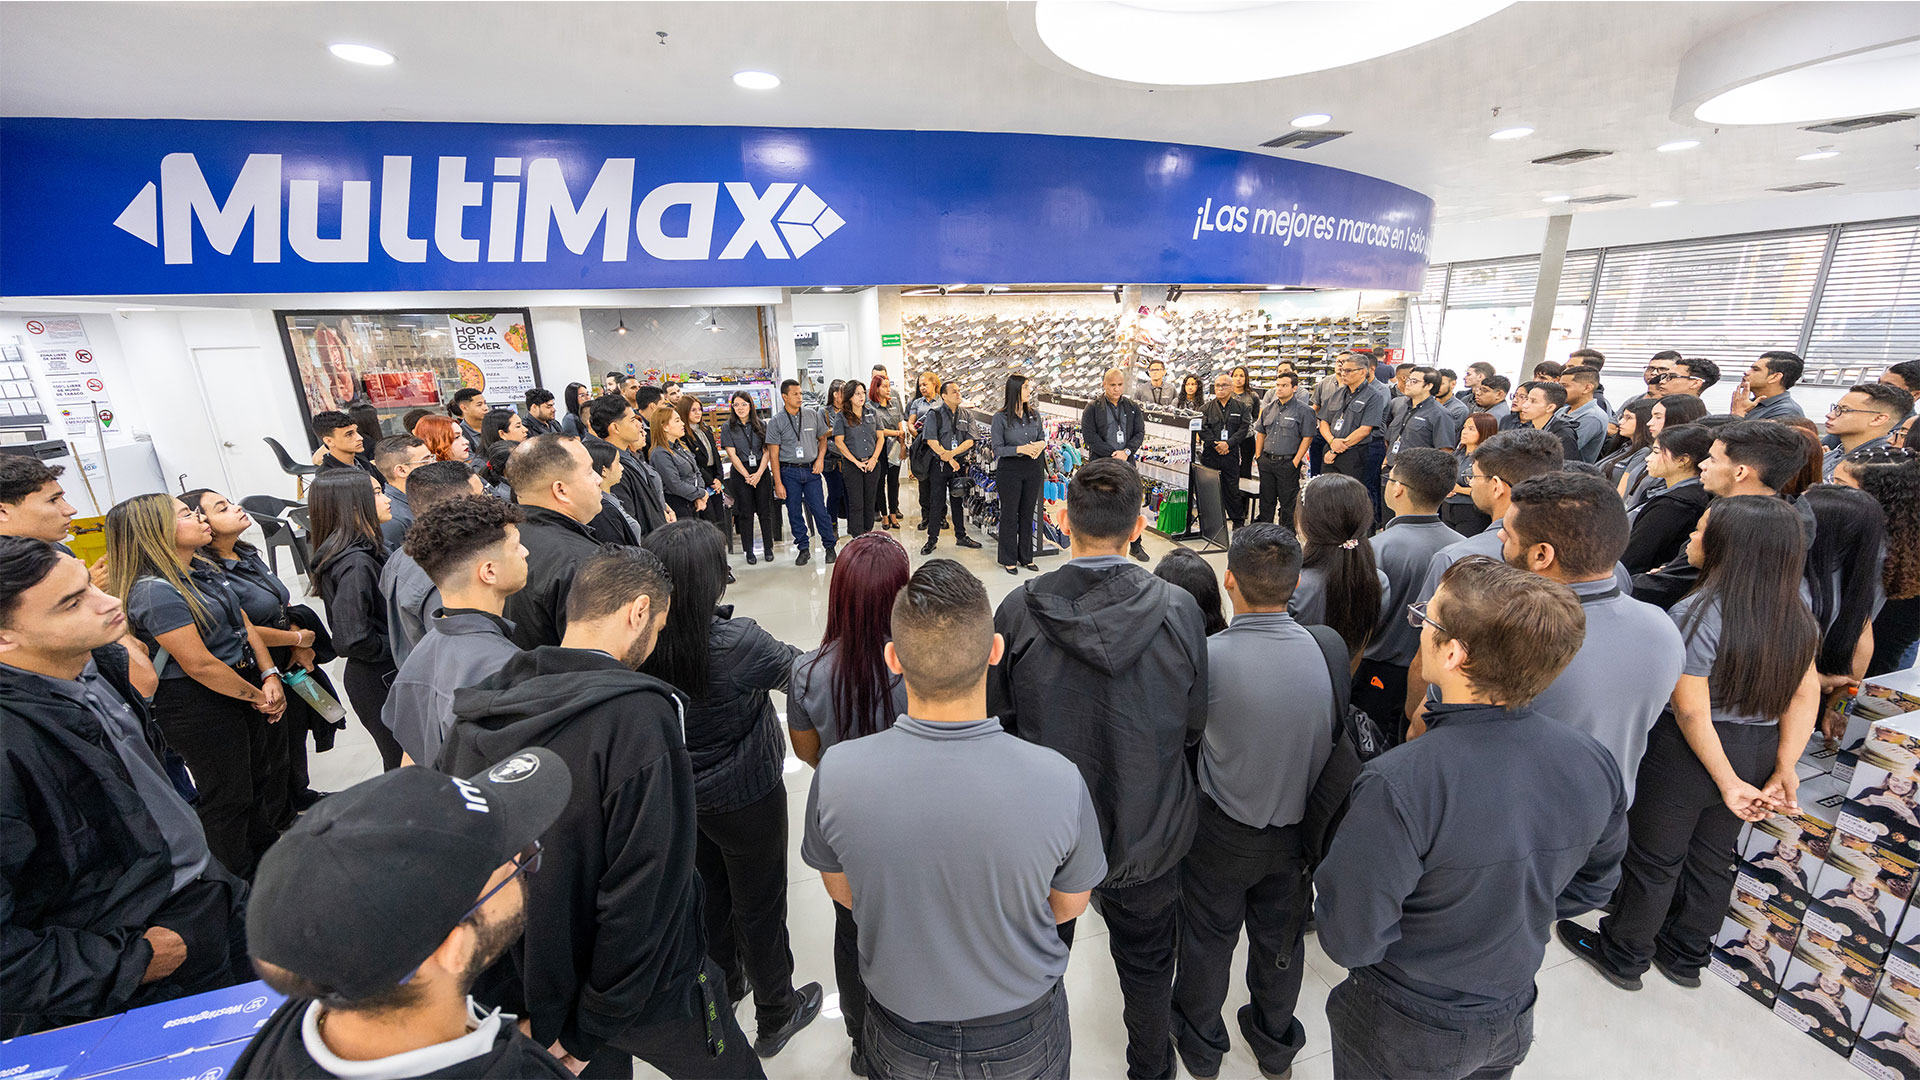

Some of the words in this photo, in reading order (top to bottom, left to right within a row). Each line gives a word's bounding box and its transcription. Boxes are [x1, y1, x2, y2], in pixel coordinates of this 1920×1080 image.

[160, 152, 798, 265] MultiMax
[1192, 197, 1249, 240] ¡Las
[1252, 203, 1335, 247] mejores
[1336, 215, 1391, 248] marcas
[1390, 228, 1404, 250] en
[455, 326, 497, 335] HORA
[457, 335, 476, 343] DE
[459, 342, 500, 350] COMER
[162, 1003, 243, 1029] Westinghouse
